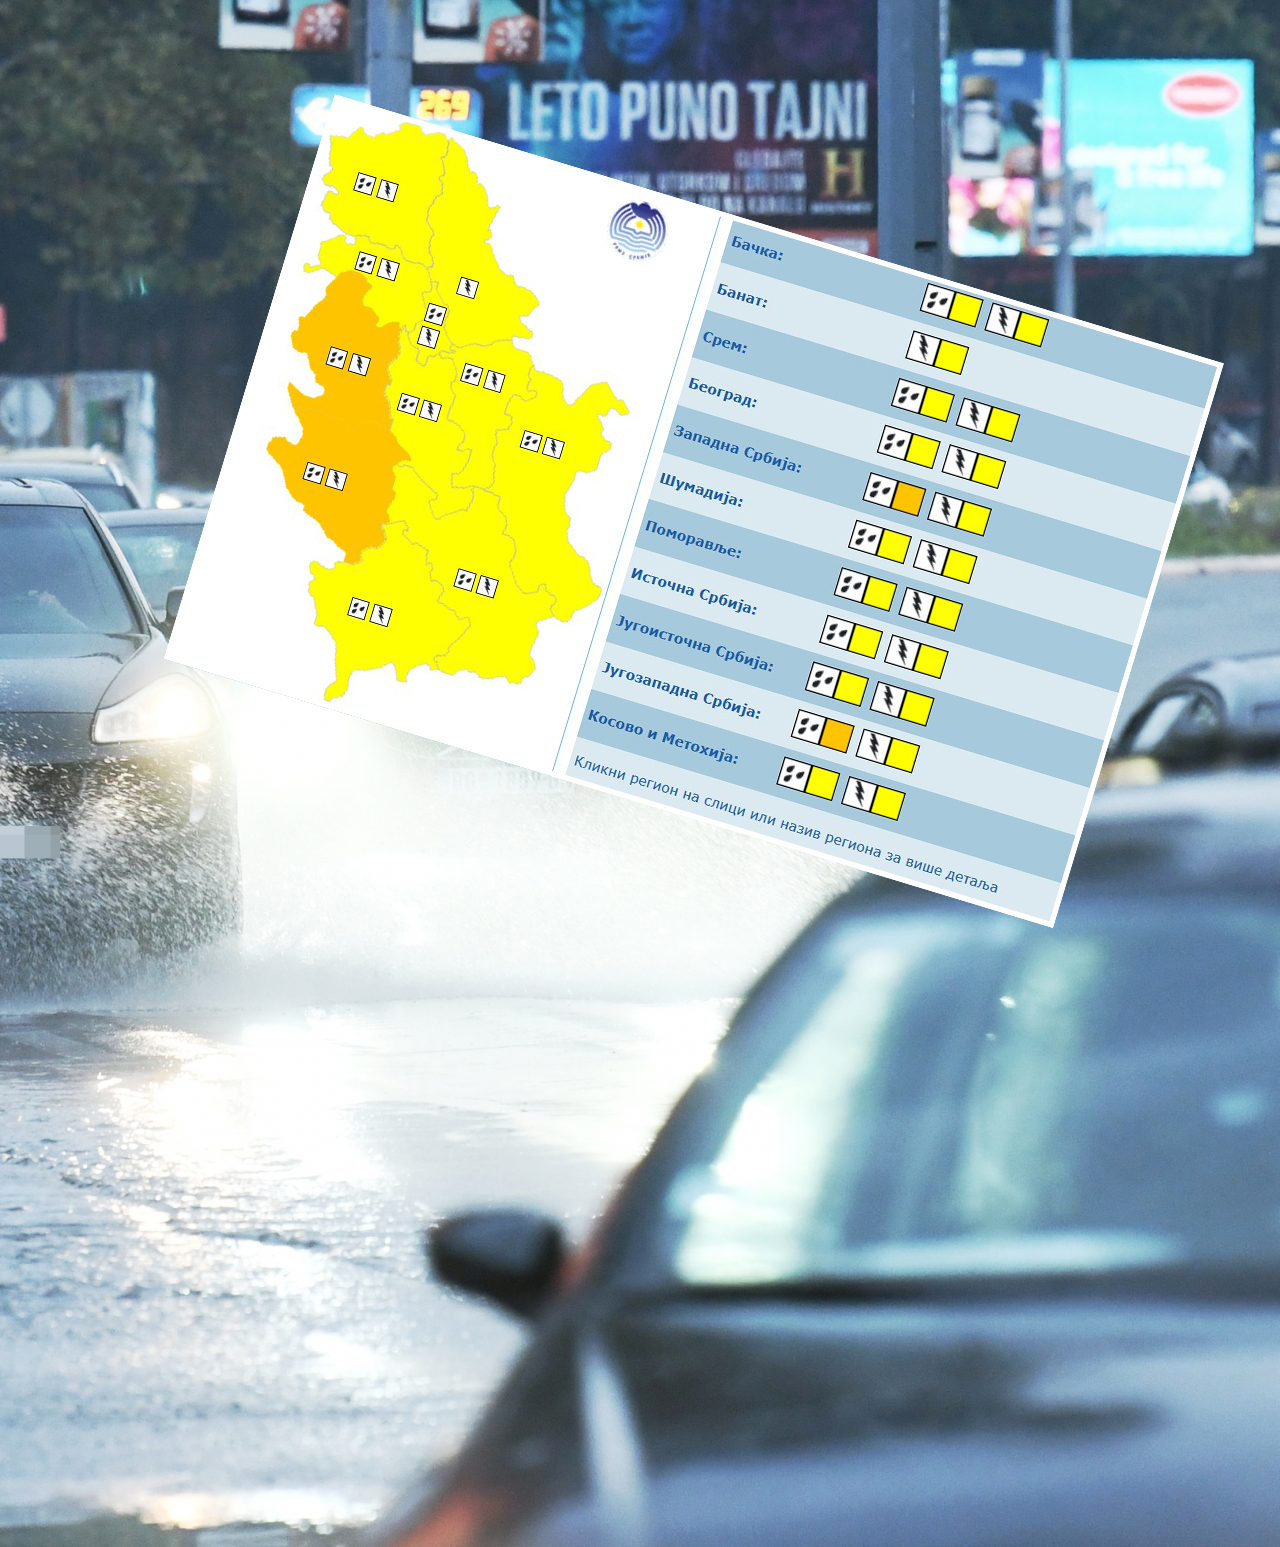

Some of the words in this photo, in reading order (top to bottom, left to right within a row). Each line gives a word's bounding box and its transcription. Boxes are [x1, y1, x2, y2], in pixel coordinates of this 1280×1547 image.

[419, 88, 471, 120] 269
[507, 80, 607, 141] LETO
[620, 80, 737, 141] PUNO
[748, 80, 868, 141] TAJNI
